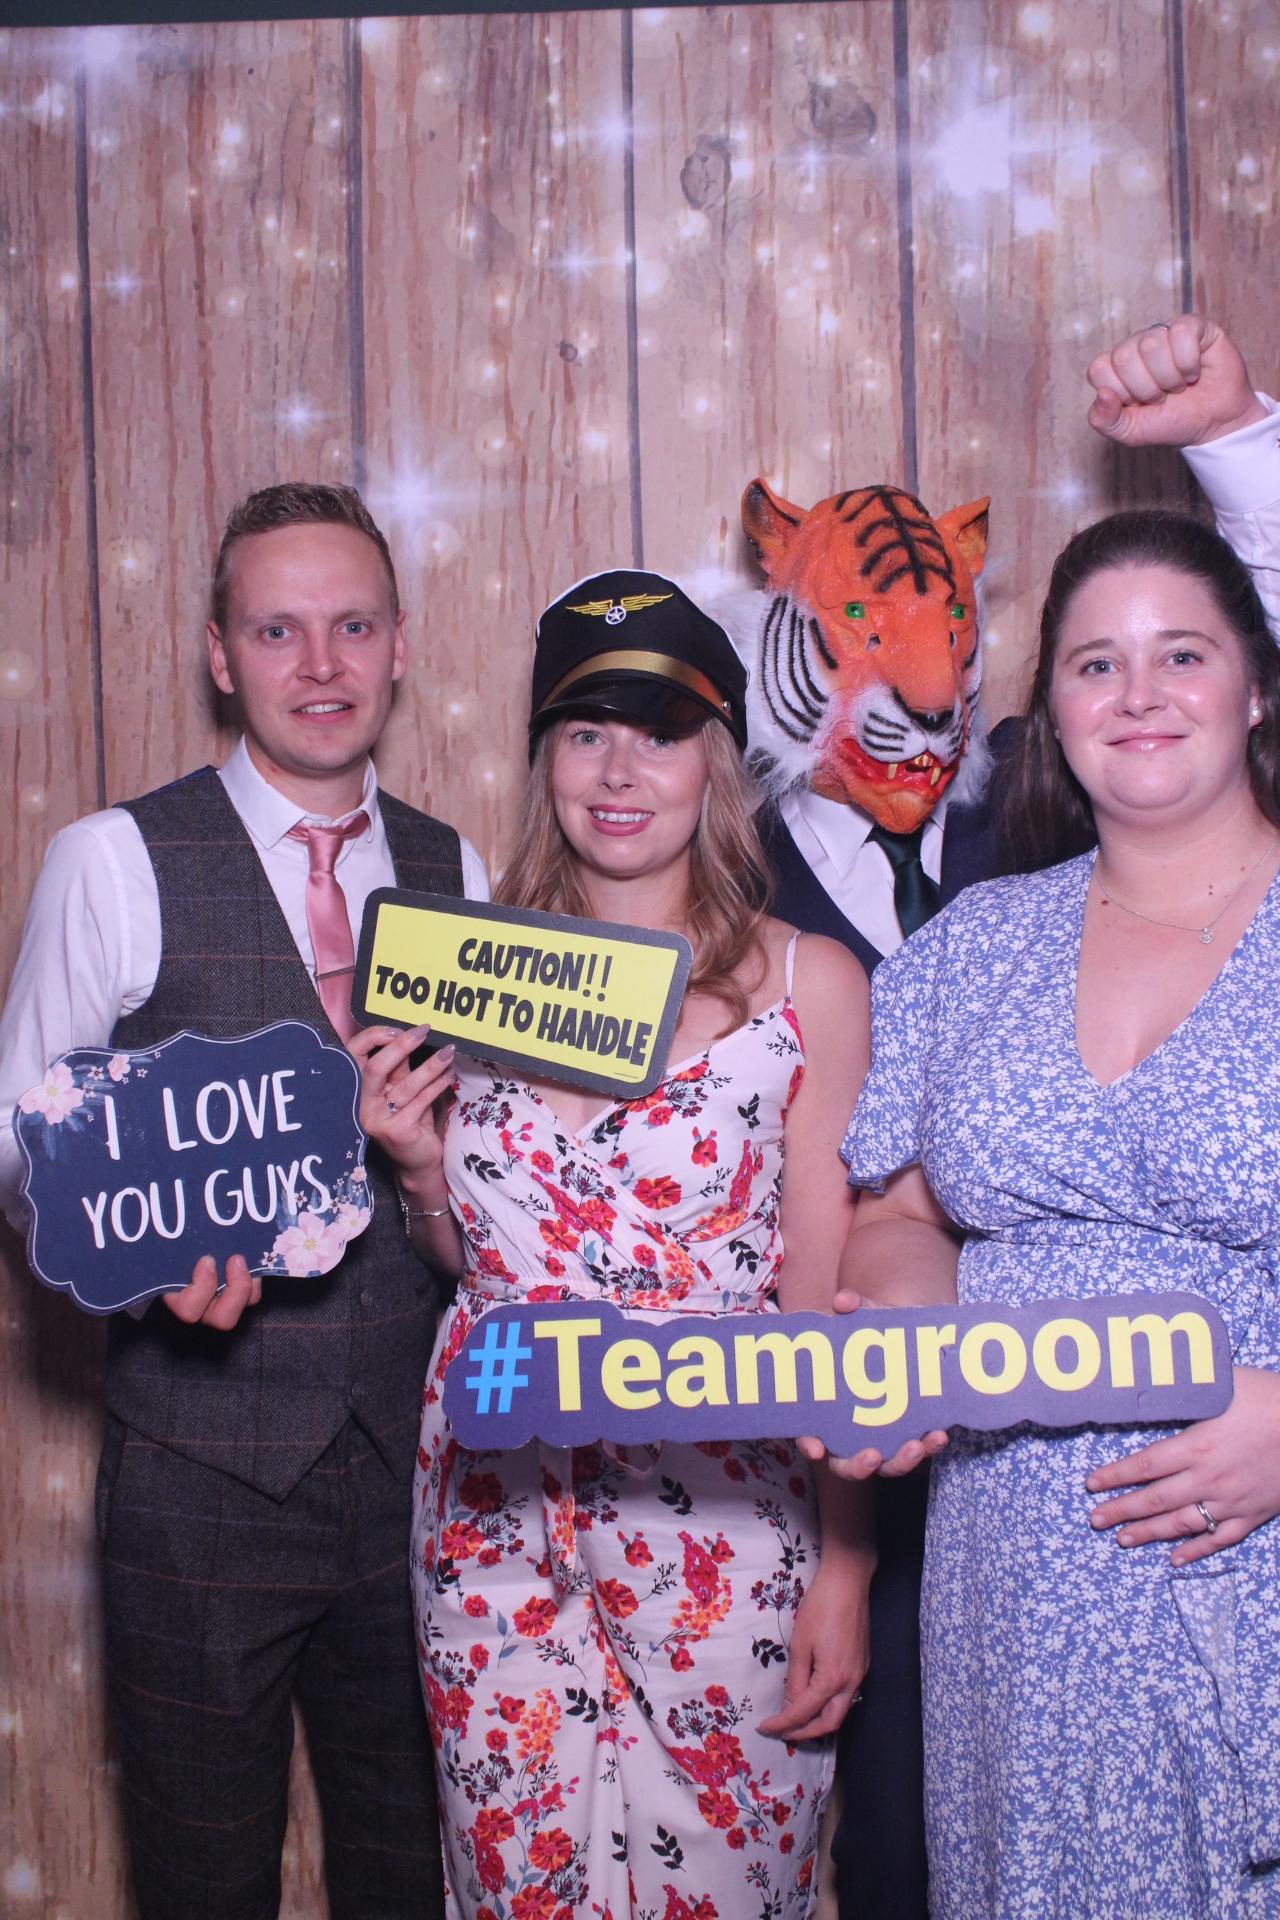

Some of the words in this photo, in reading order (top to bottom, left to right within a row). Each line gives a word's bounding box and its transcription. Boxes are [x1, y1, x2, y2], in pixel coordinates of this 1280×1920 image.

[375, 965, 430, 1005] TOO
[433, 980, 494, 1021] HOT
[498, 993, 534, 1033] TO
[536, 1003, 653, 1066] HANDLE
[457, 938, 613, 1002] CAUTION!!
[105, 1095, 120, 1160] I
[162, 1070, 302, 1151] LOVE
[81, 1179, 186, 1249] YOU
[204, 1154, 331, 1226] GUYS
[465, 1312, 1216, 1427] #Teamgroom
